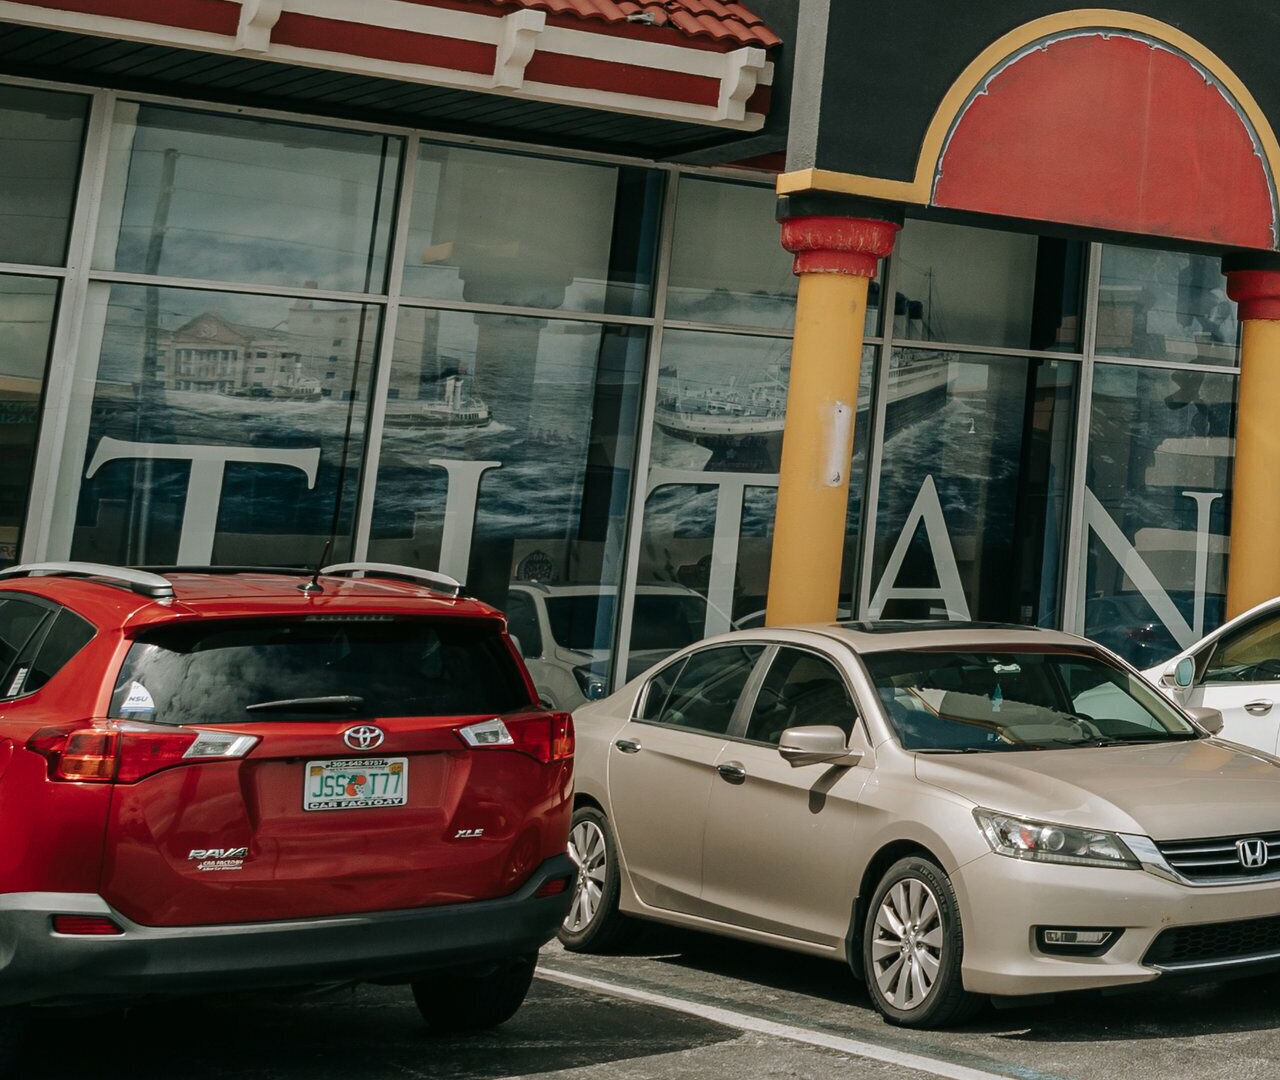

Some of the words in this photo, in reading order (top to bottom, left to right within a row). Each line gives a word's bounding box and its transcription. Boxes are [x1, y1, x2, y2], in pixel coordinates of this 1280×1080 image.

[312, 774, 346, 797] JSS
[369, 773, 401, 795] T77
[310, 801, 336, 809] CAR
[342, 798, 401, 807] FACTORY
[454, 828, 484, 838] XLE
[188, 847, 248, 860] RAV4
